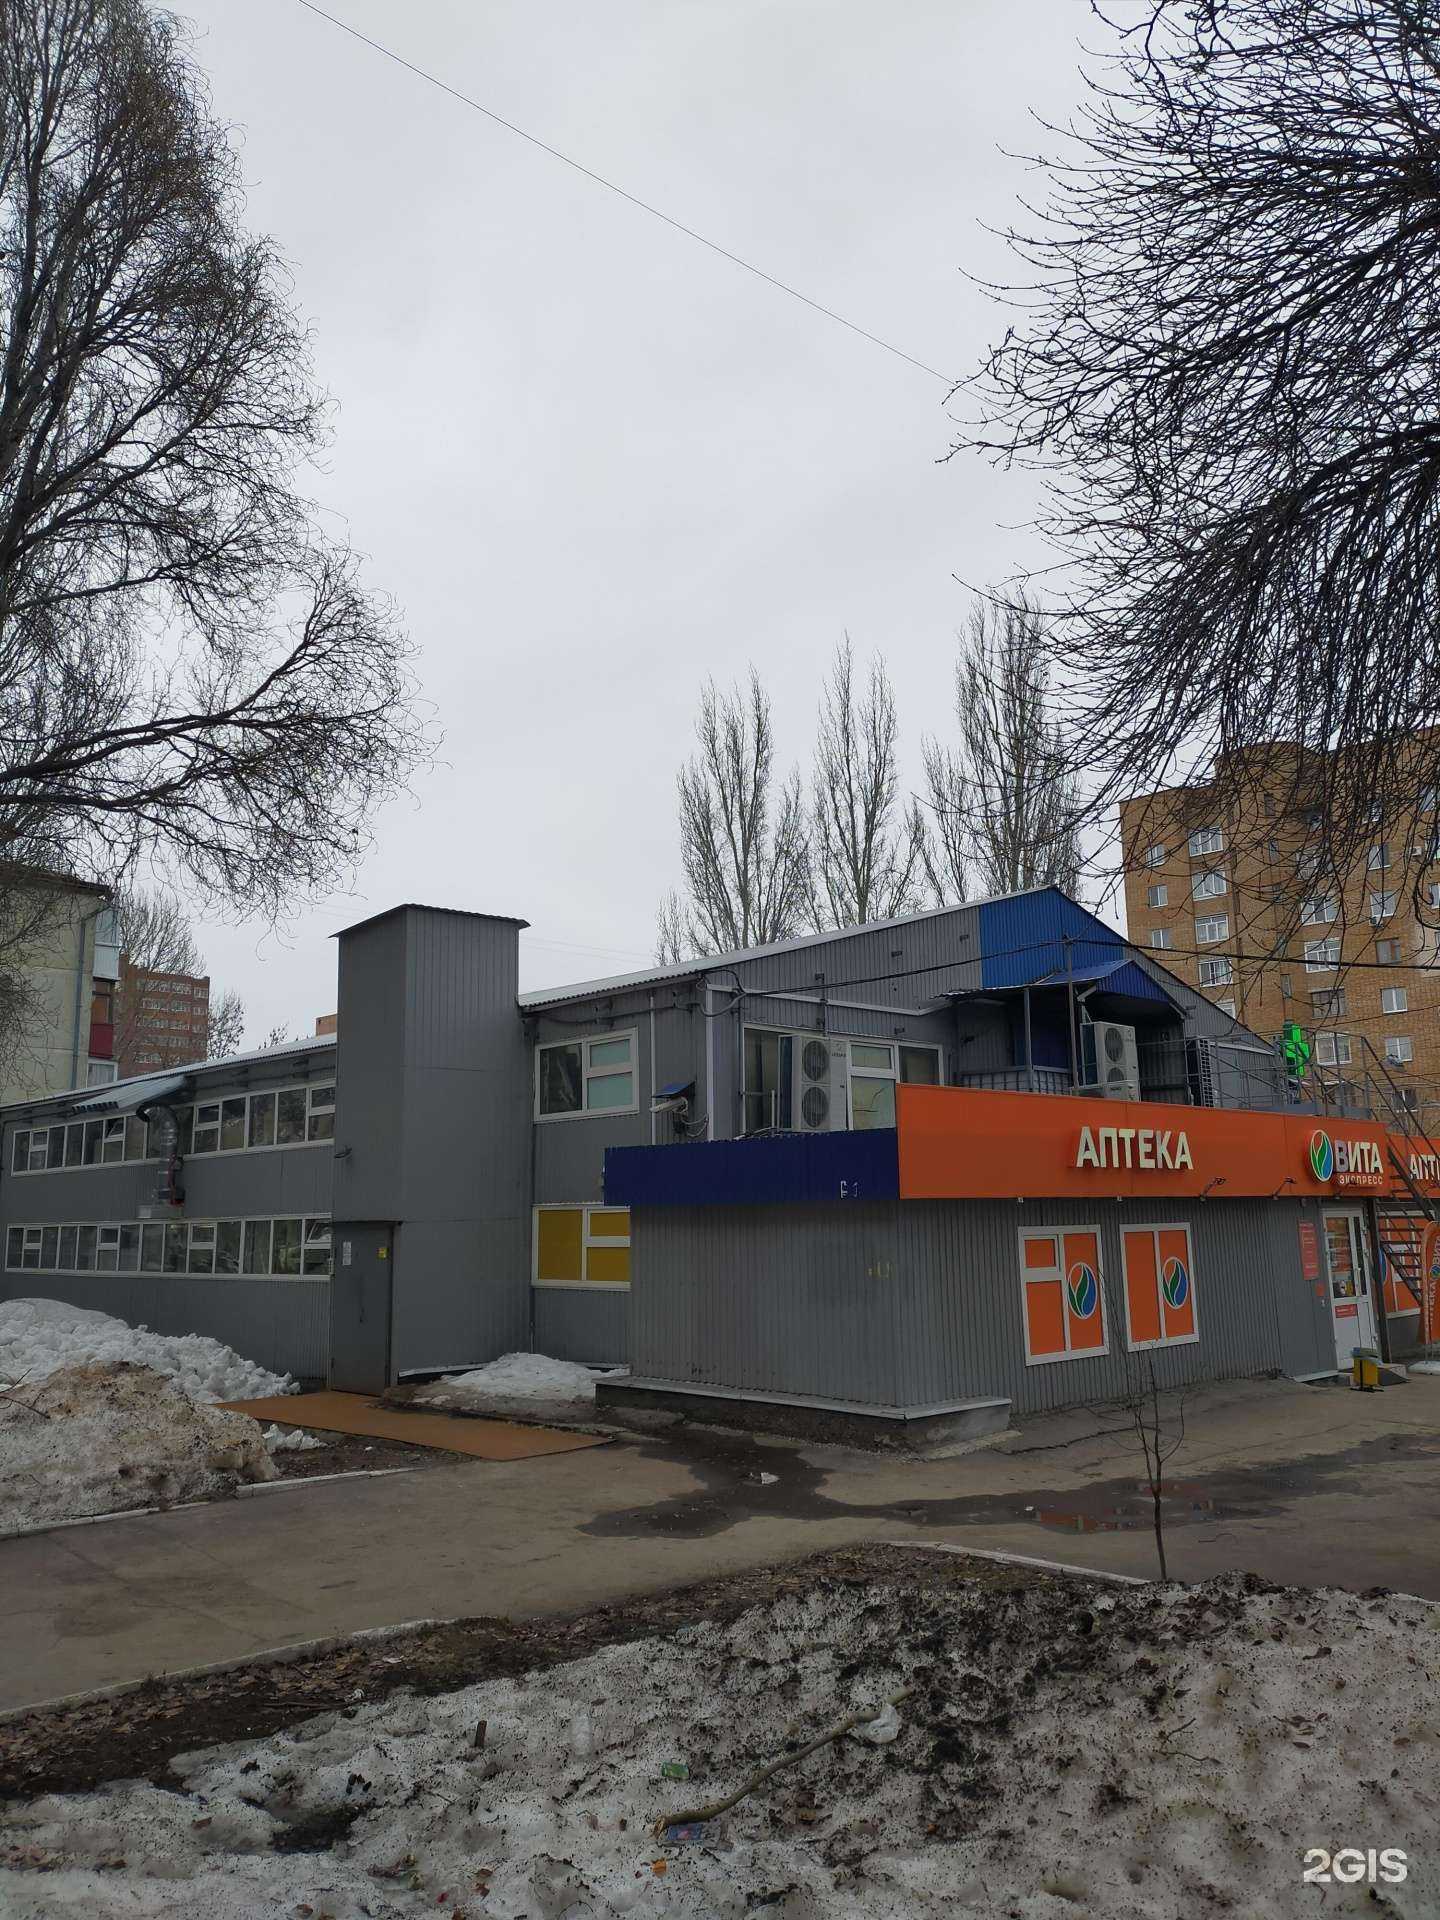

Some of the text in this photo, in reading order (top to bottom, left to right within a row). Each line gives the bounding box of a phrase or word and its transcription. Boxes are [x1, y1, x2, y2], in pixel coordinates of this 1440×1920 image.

[1076, 1126, 1194, 1170] АПТЕКА
[1335, 1140, 1384, 1174] ВИТА
[1339, 1175, 1383, 1185] ЭКСПРЕСС
[1410, 1154, 1440, 1180] АПТ
